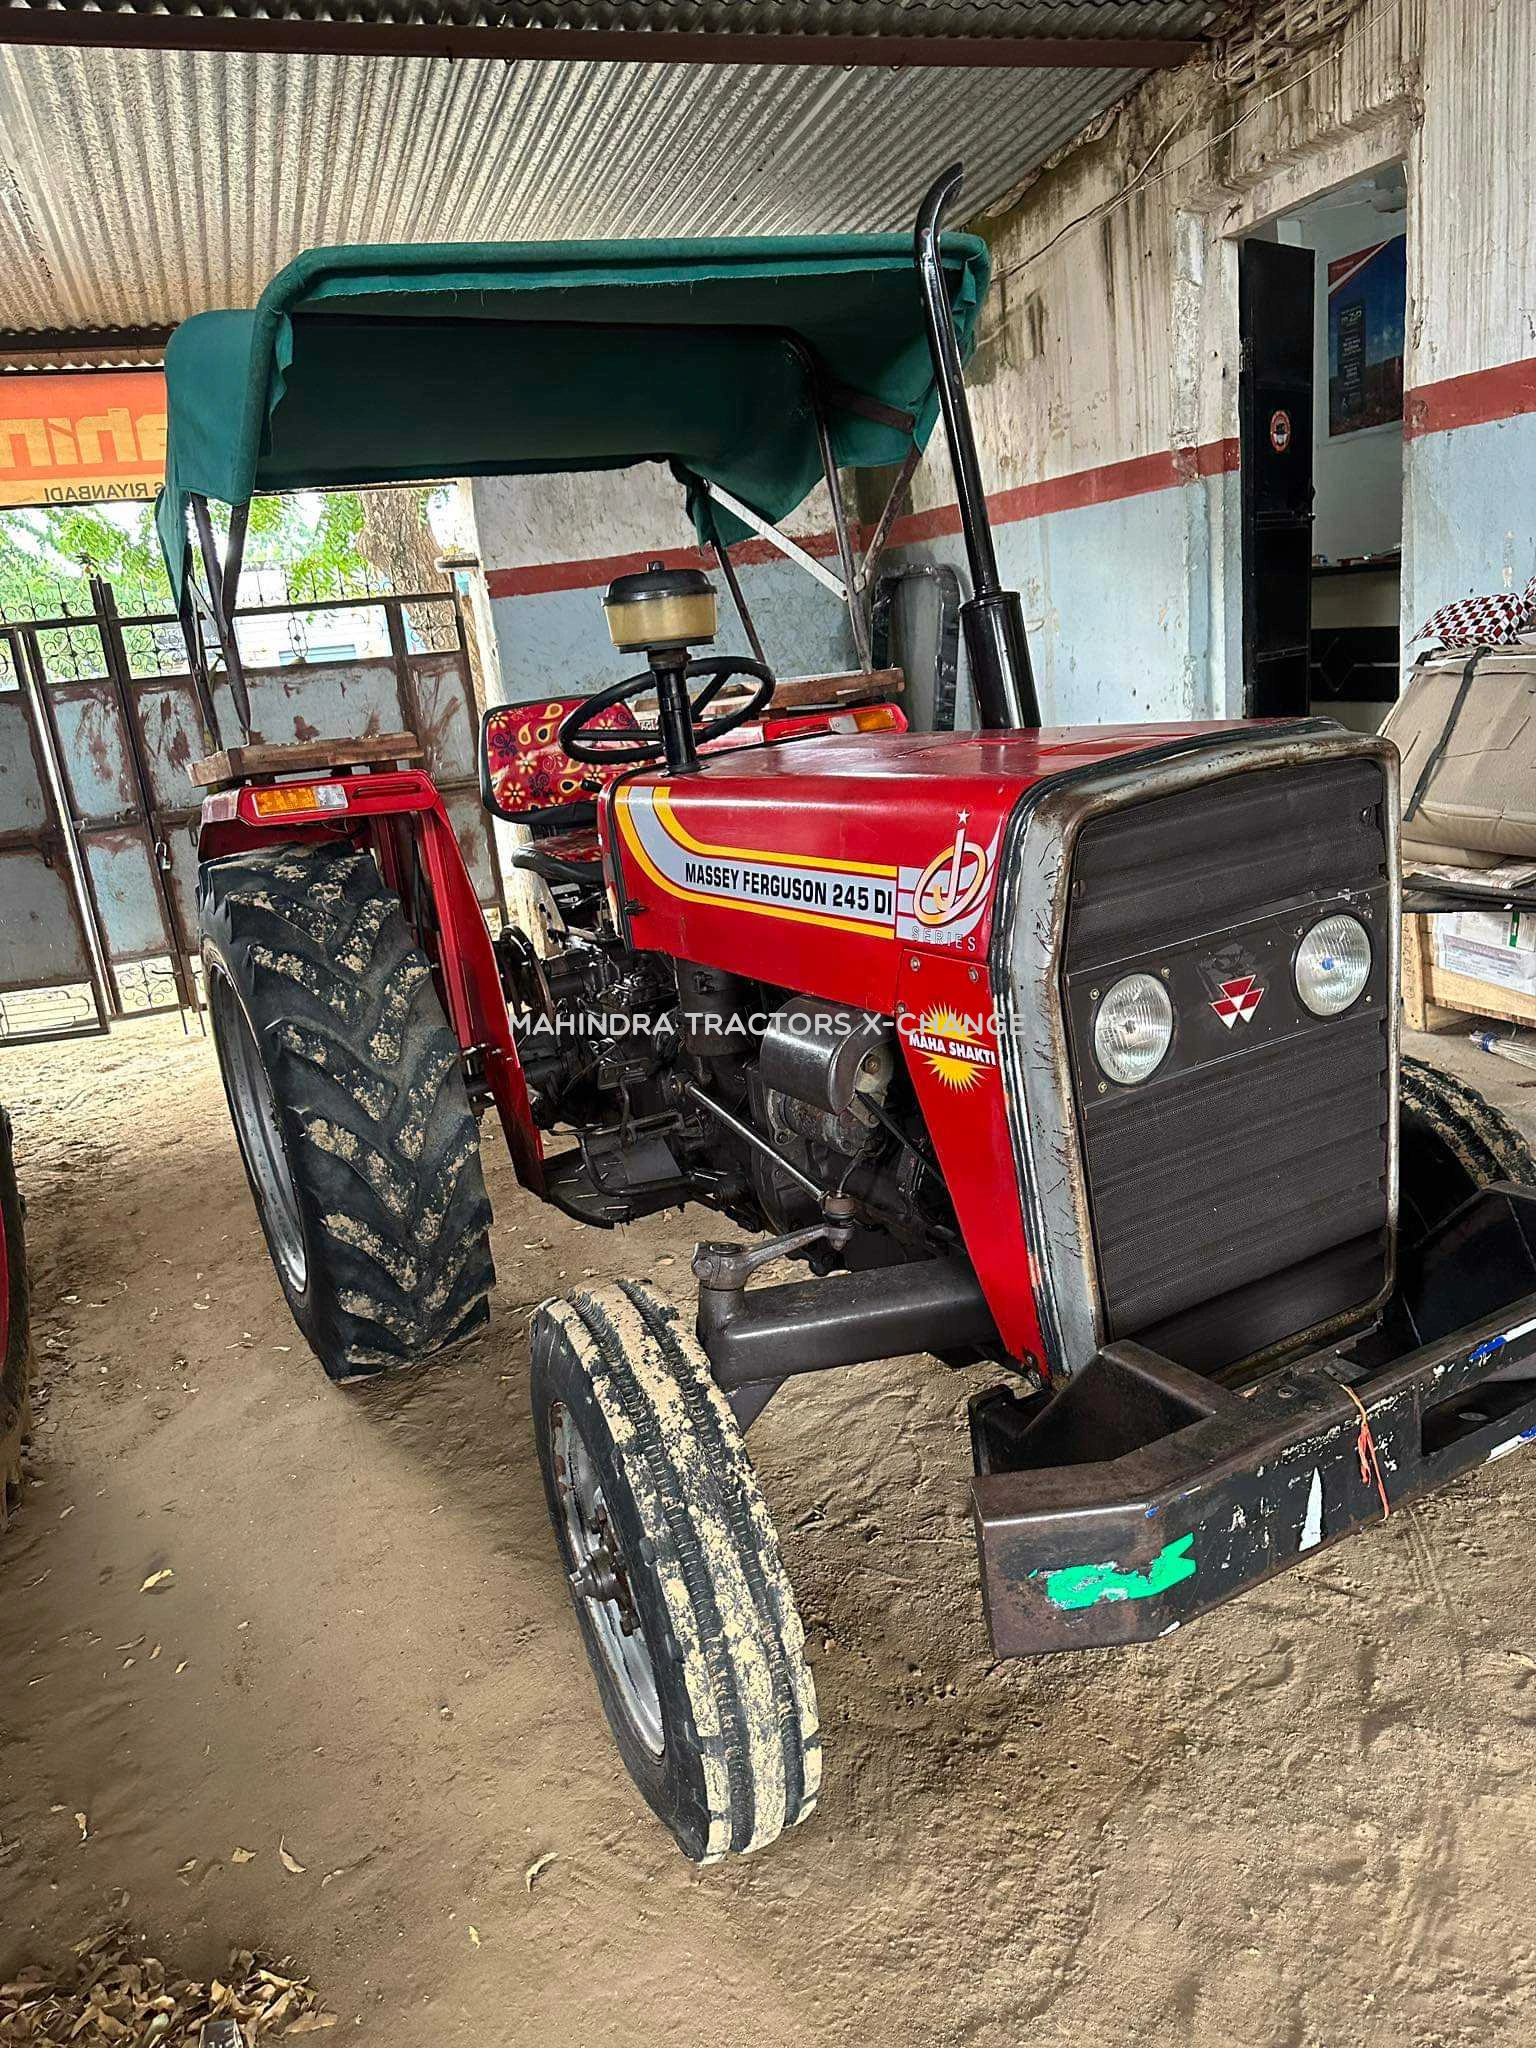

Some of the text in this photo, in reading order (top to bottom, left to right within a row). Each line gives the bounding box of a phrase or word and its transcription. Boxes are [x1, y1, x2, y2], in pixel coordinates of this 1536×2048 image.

[685, 862, 893, 916] MASSEY FERGUSON 245 DI
[911, 925, 976, 951] SERIES
[908, 1033, 997, 1066] MAHA SHAKTI
